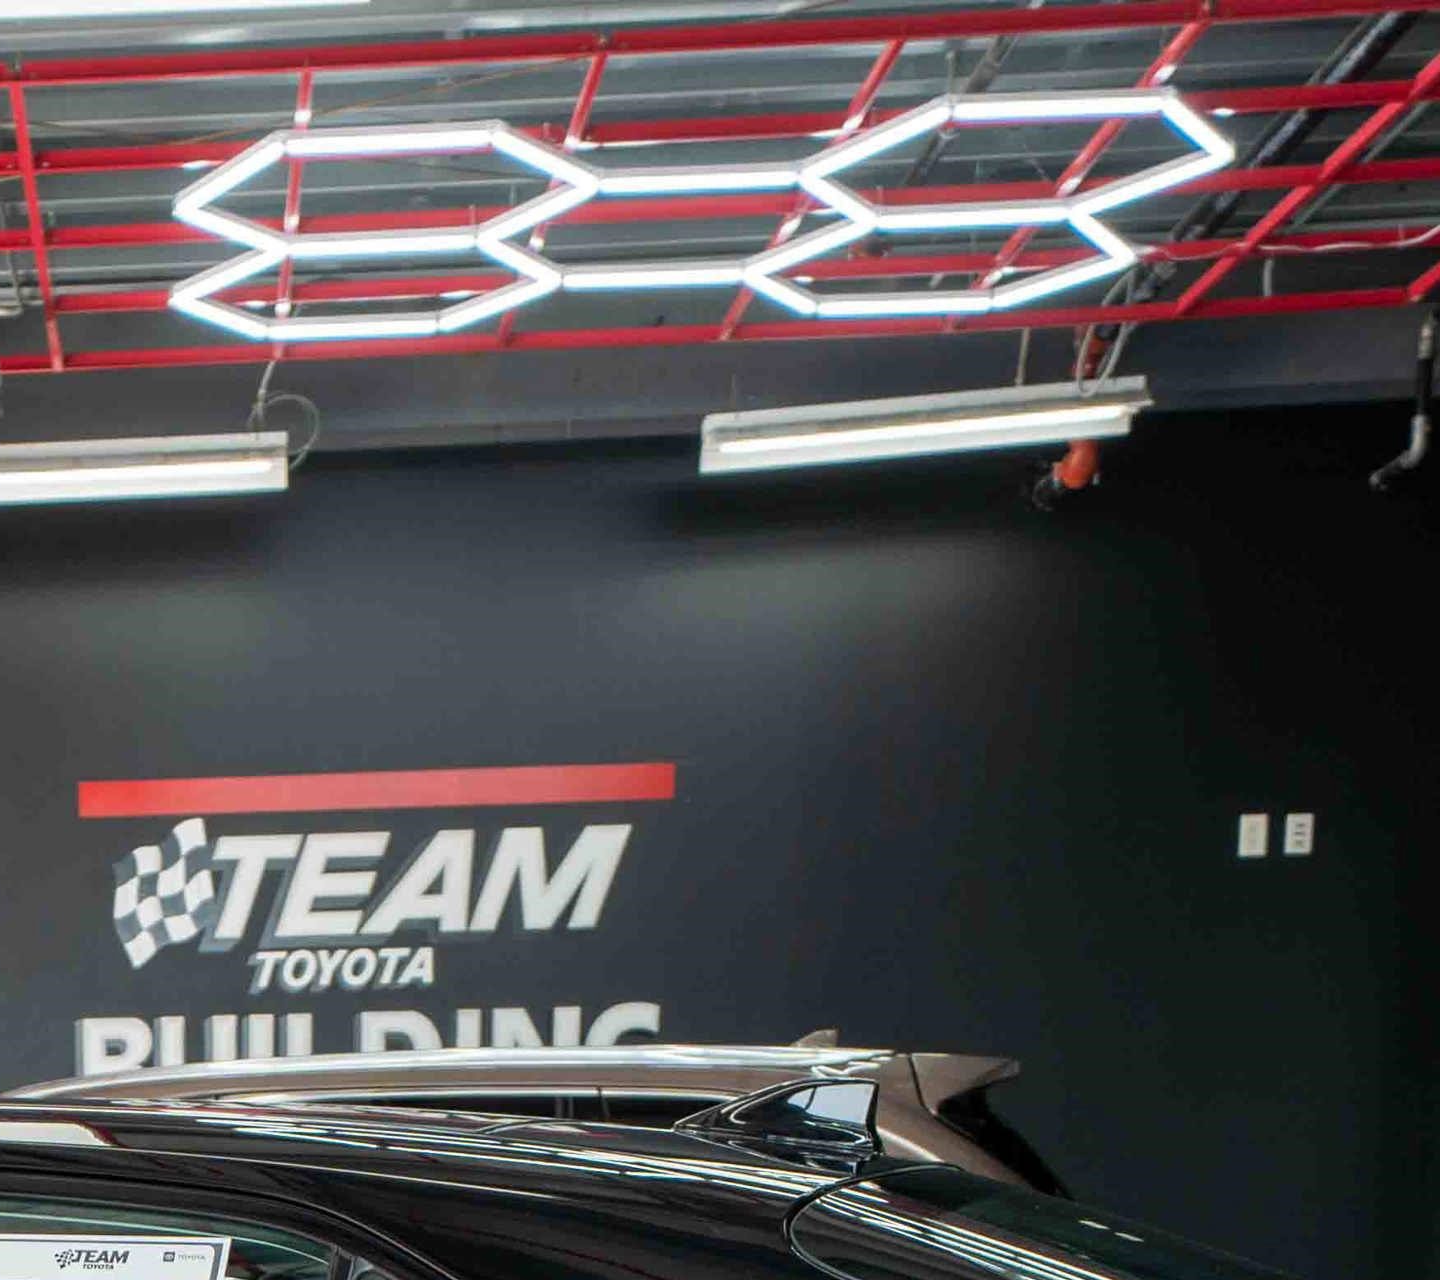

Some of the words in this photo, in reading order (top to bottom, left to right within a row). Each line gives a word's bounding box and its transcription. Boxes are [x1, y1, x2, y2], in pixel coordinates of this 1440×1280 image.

[204, 823, 632, 944] TEAM
[250, 946, 435, 993] TOYOTA
[73, 1250, 130, 1264] TEAM
